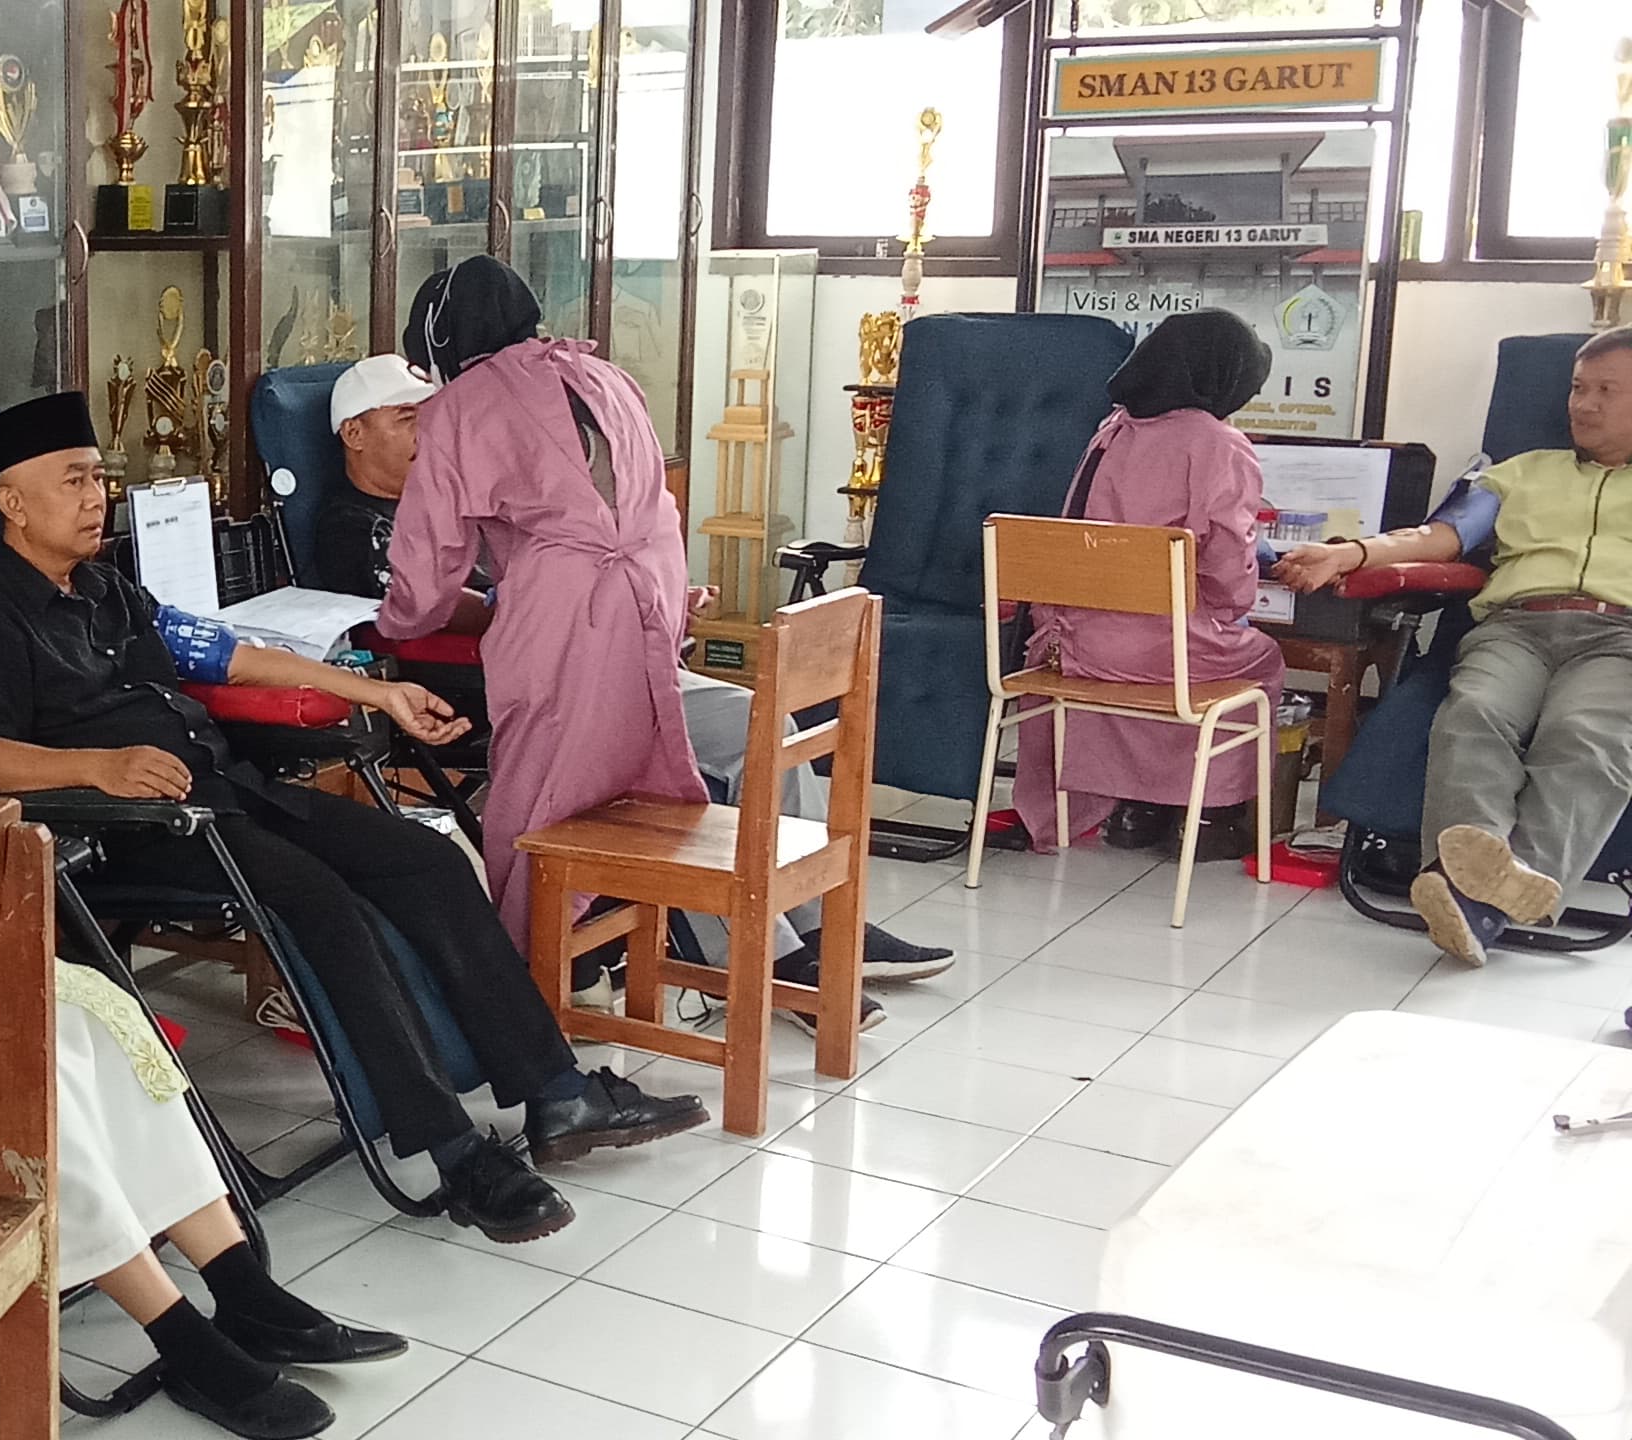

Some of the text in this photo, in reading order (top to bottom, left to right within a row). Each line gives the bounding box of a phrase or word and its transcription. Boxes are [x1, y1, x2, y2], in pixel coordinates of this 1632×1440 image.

[1077, 62, 1353, 99] SMAN 13 GARUT
[1127, 228, 1302, 244] SMA NEGERI 13 GARUT
[1073, 290, 1201, 312] Visi & Misi
